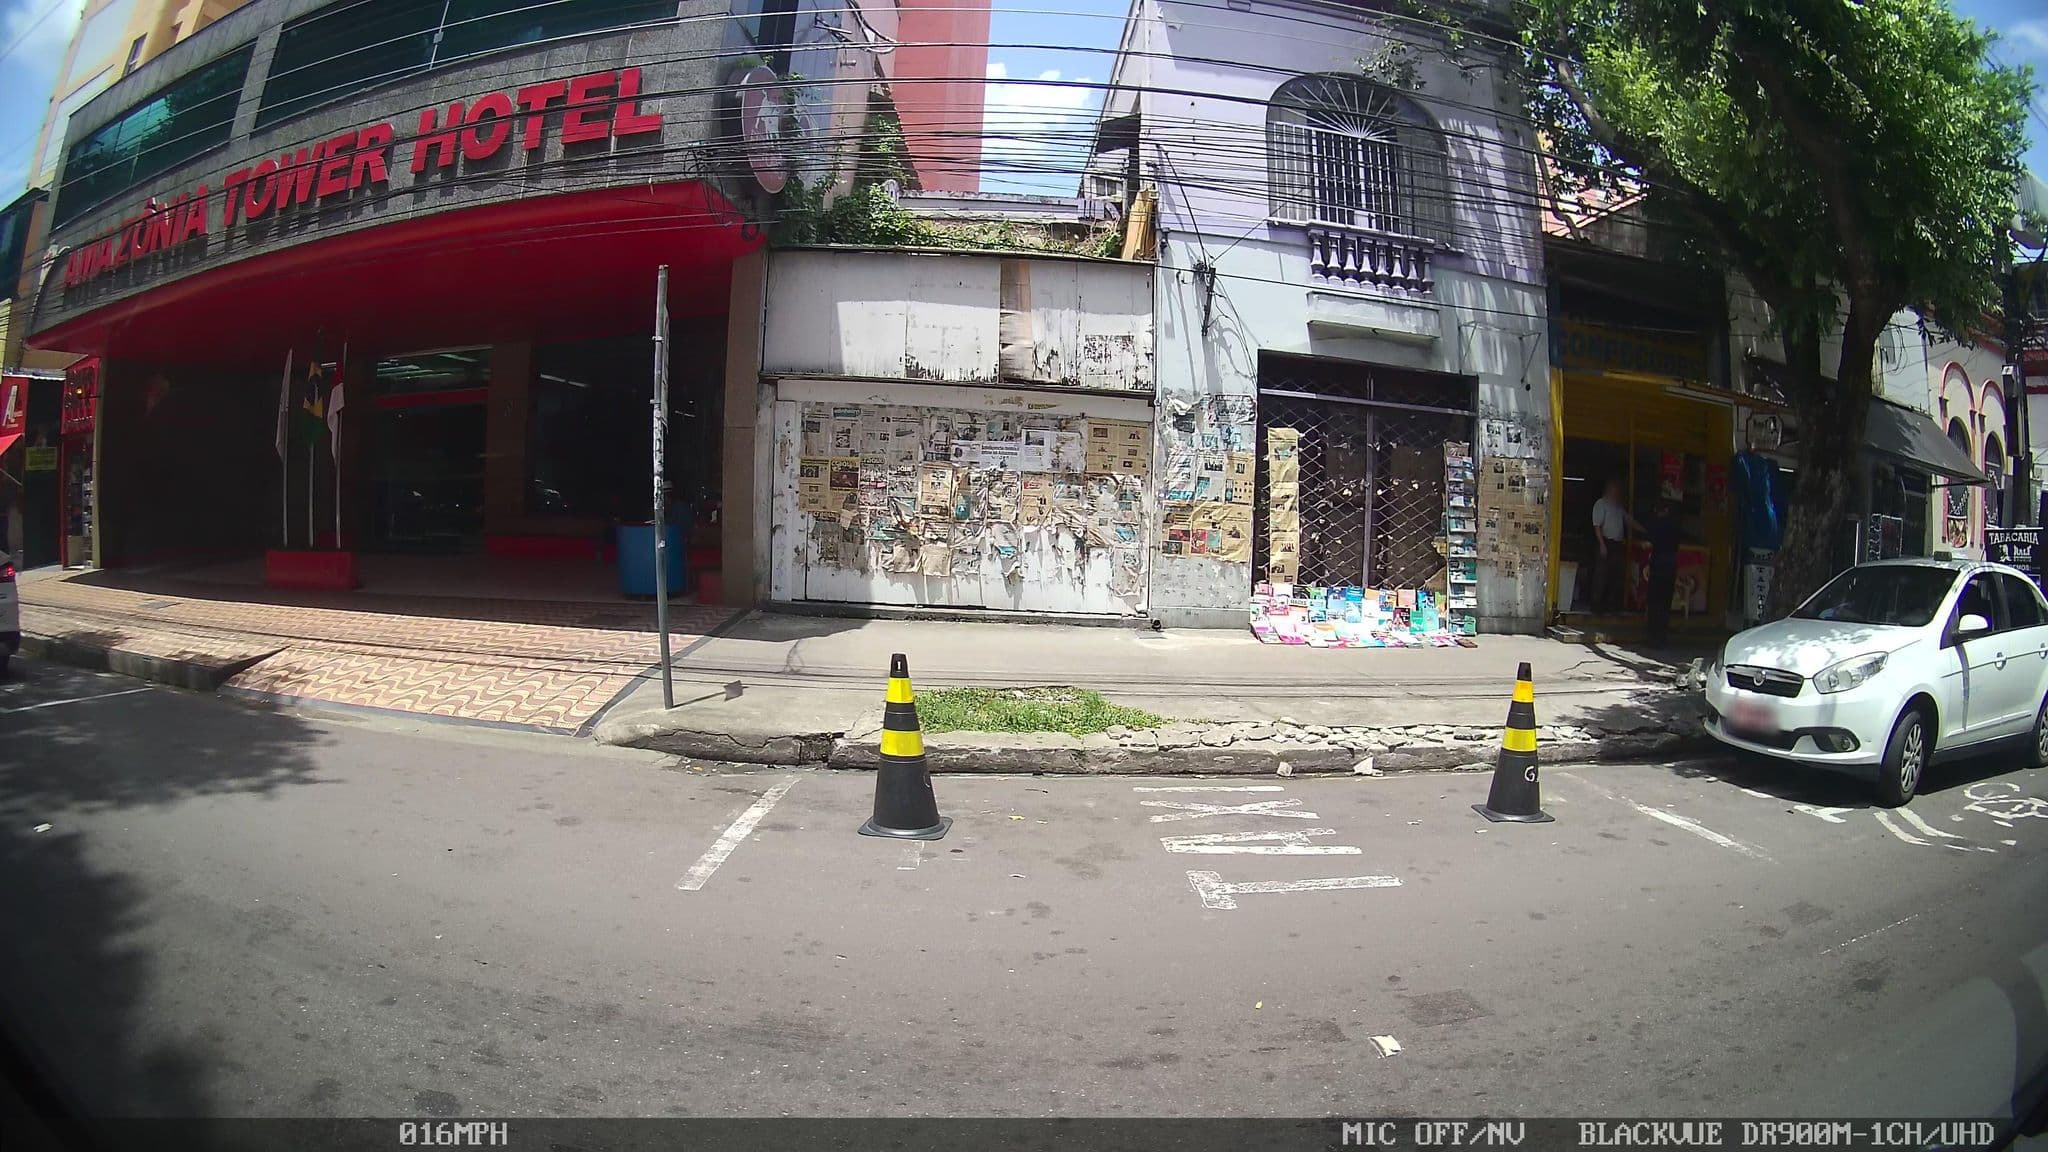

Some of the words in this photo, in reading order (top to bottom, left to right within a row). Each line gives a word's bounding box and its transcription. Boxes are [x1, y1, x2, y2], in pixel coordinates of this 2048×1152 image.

[64, 184, 208, 287] AMAZÔNIA
[224, 122, 394, 226] TOWER
[410, 67, 662, 174] HOTEL
[1988, 531, 2040, 546] TABACARIA
[1133, 785, 1403, 910] TAXI
